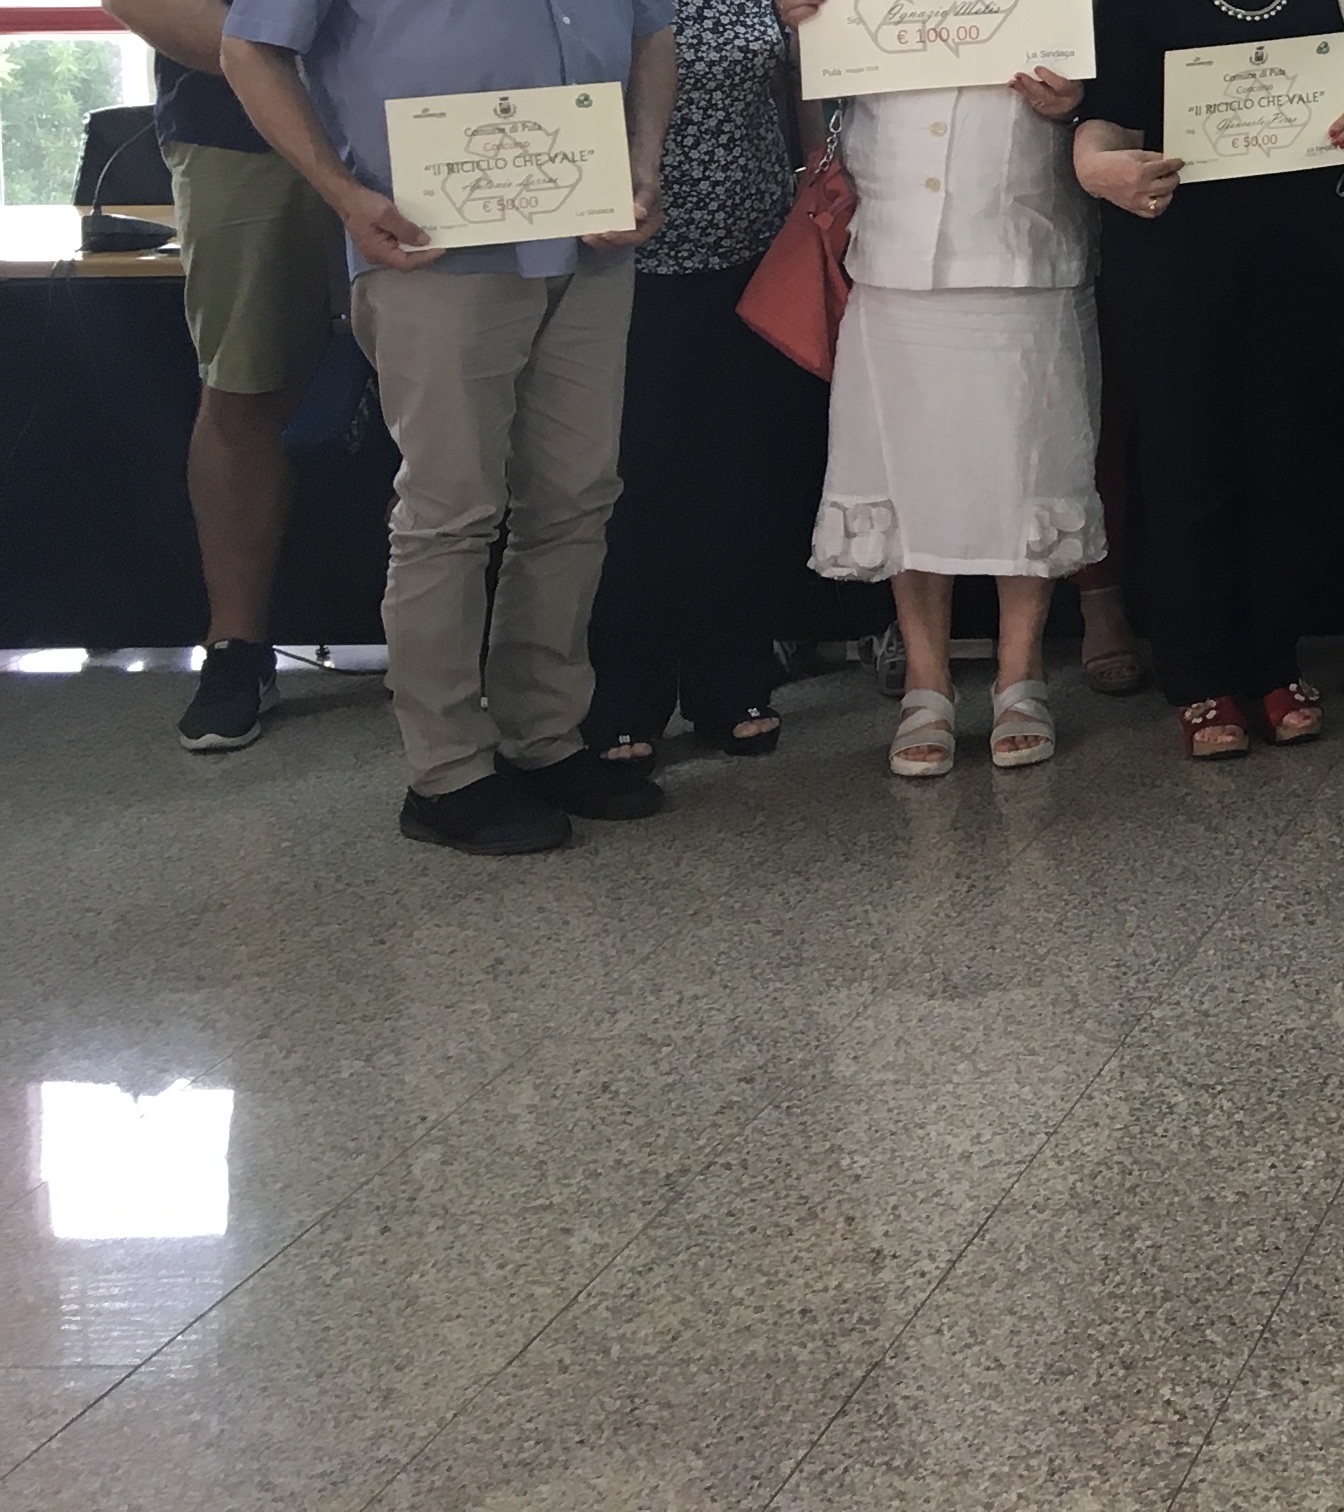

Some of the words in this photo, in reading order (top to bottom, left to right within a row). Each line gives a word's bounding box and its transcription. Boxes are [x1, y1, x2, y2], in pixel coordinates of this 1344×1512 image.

[888, 2, 949, 26] Ignazio
[954, 0, 1001, 17] Melis
[896, 29, 909, 44] €
[915, 24, 980, 45] 100,00
[1026, 51, 1038, 59] La
[822, 69, 842, 77] Pula
[1223, 72, 1256, 82] Comune
[1269, 69, 1286, 77] Pula
[1236, 84, 1273, 95] Concorso
[1206, 99, 1255, 115] RICICLO
[1258, 95, 1283, 108] CHE
[465, 126, 505, 138] Comune
[509, 123, 518, 133] di
[521, 121, 543, 132] Pula
[483, 141, 530, 152] Concorso
[1231, 138, 1240, 149] €
[1243, 134, 1278, 148] 50,00
[446, 158, 507, 175] RICICLO
[512, 154, 545, 168] CHE
[482, 200, 492, 212] €
[497, 196, 538, 212] 50,00
